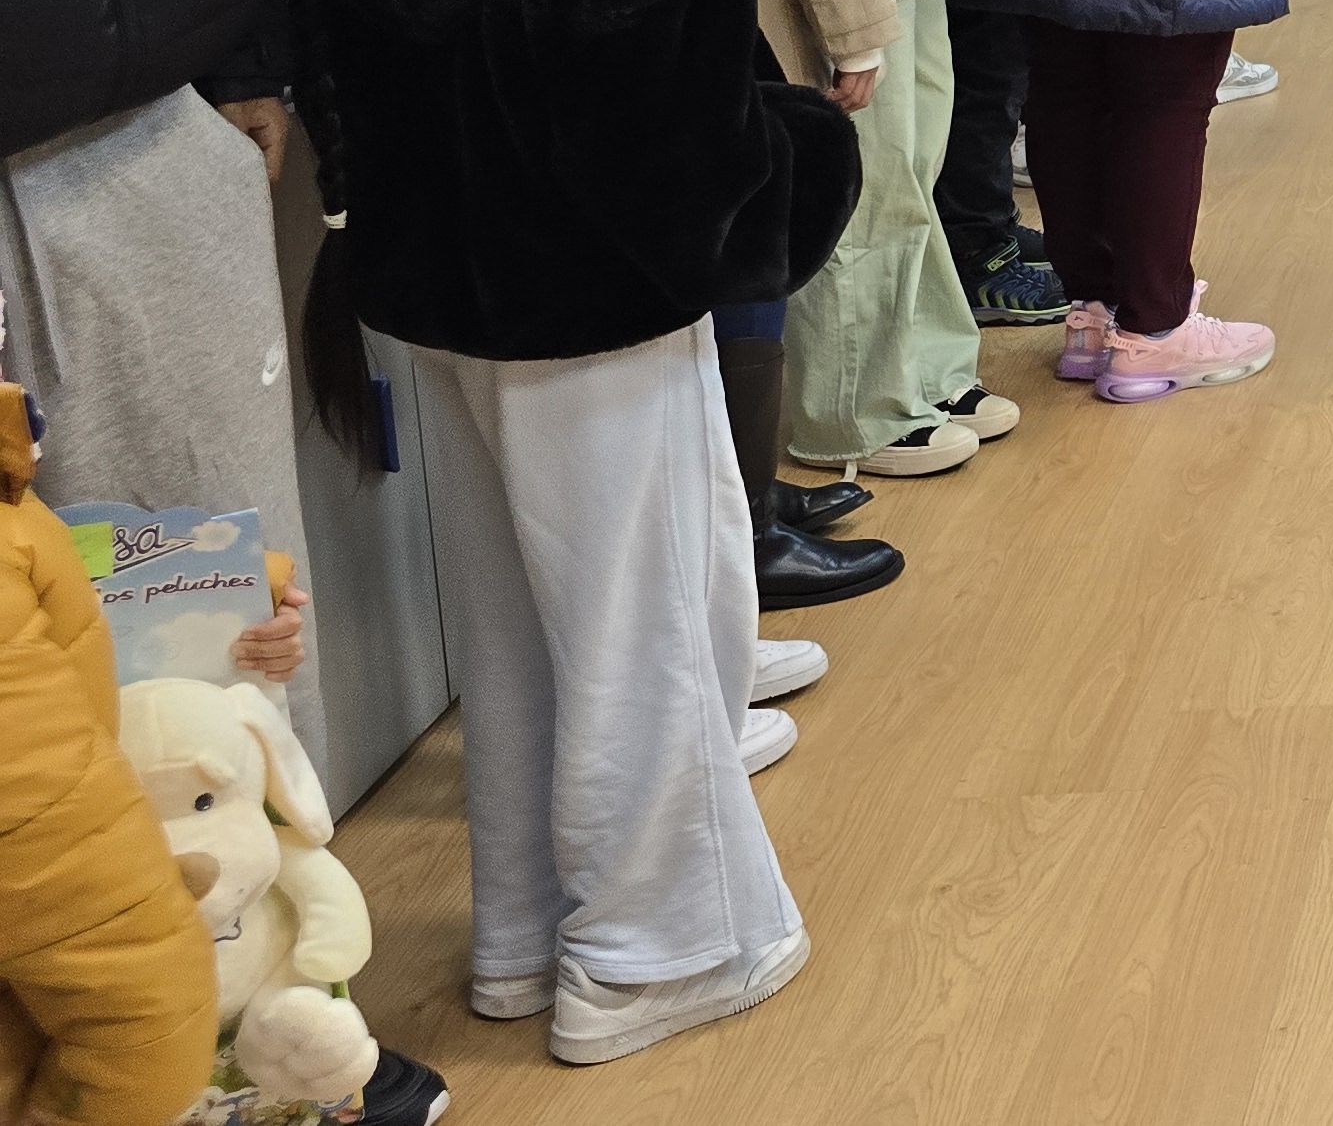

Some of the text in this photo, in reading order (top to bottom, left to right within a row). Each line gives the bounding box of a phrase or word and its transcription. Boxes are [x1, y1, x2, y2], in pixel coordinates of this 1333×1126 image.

[112, 524, 168, 562] sa
[96, 572, 257, 604] os peluches
